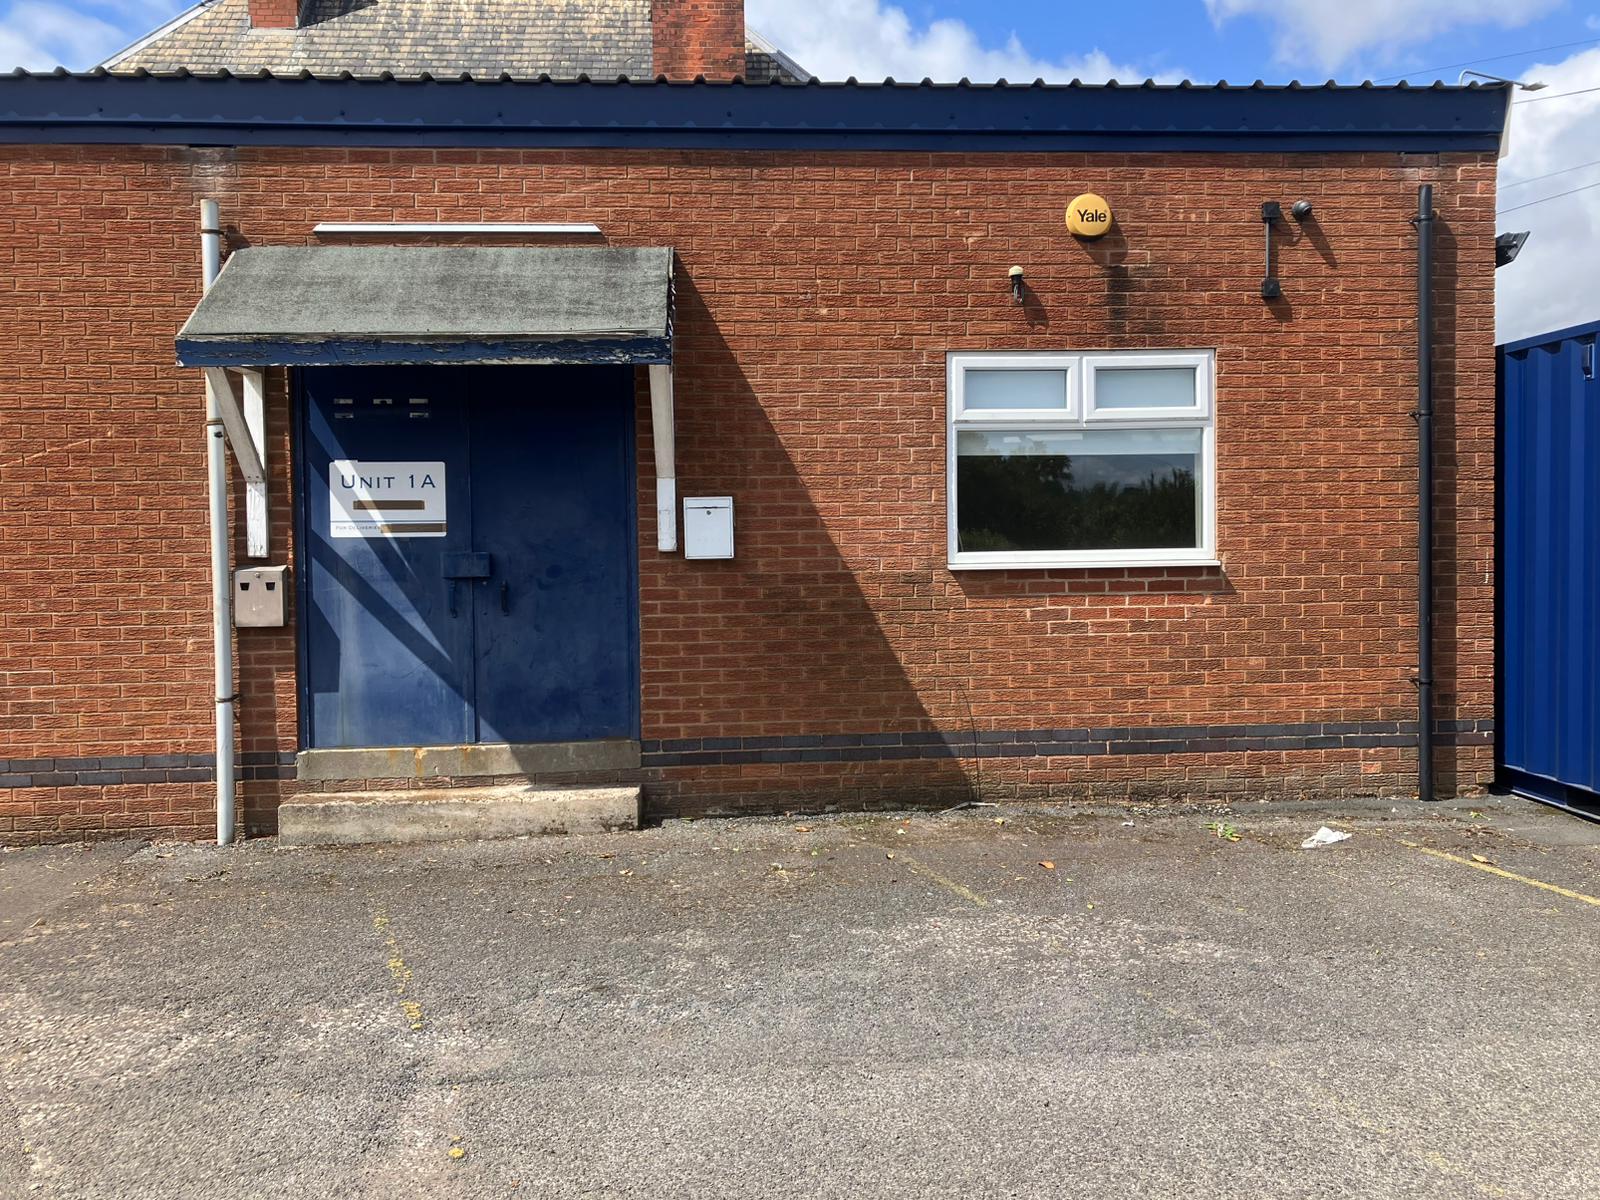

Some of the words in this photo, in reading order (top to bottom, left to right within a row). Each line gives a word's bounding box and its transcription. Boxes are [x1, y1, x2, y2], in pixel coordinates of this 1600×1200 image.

[1077, 209, 1107, 223] Yale
[341, 474, 395, 489] UNIT
[409, 474, 436, 489] 1A
